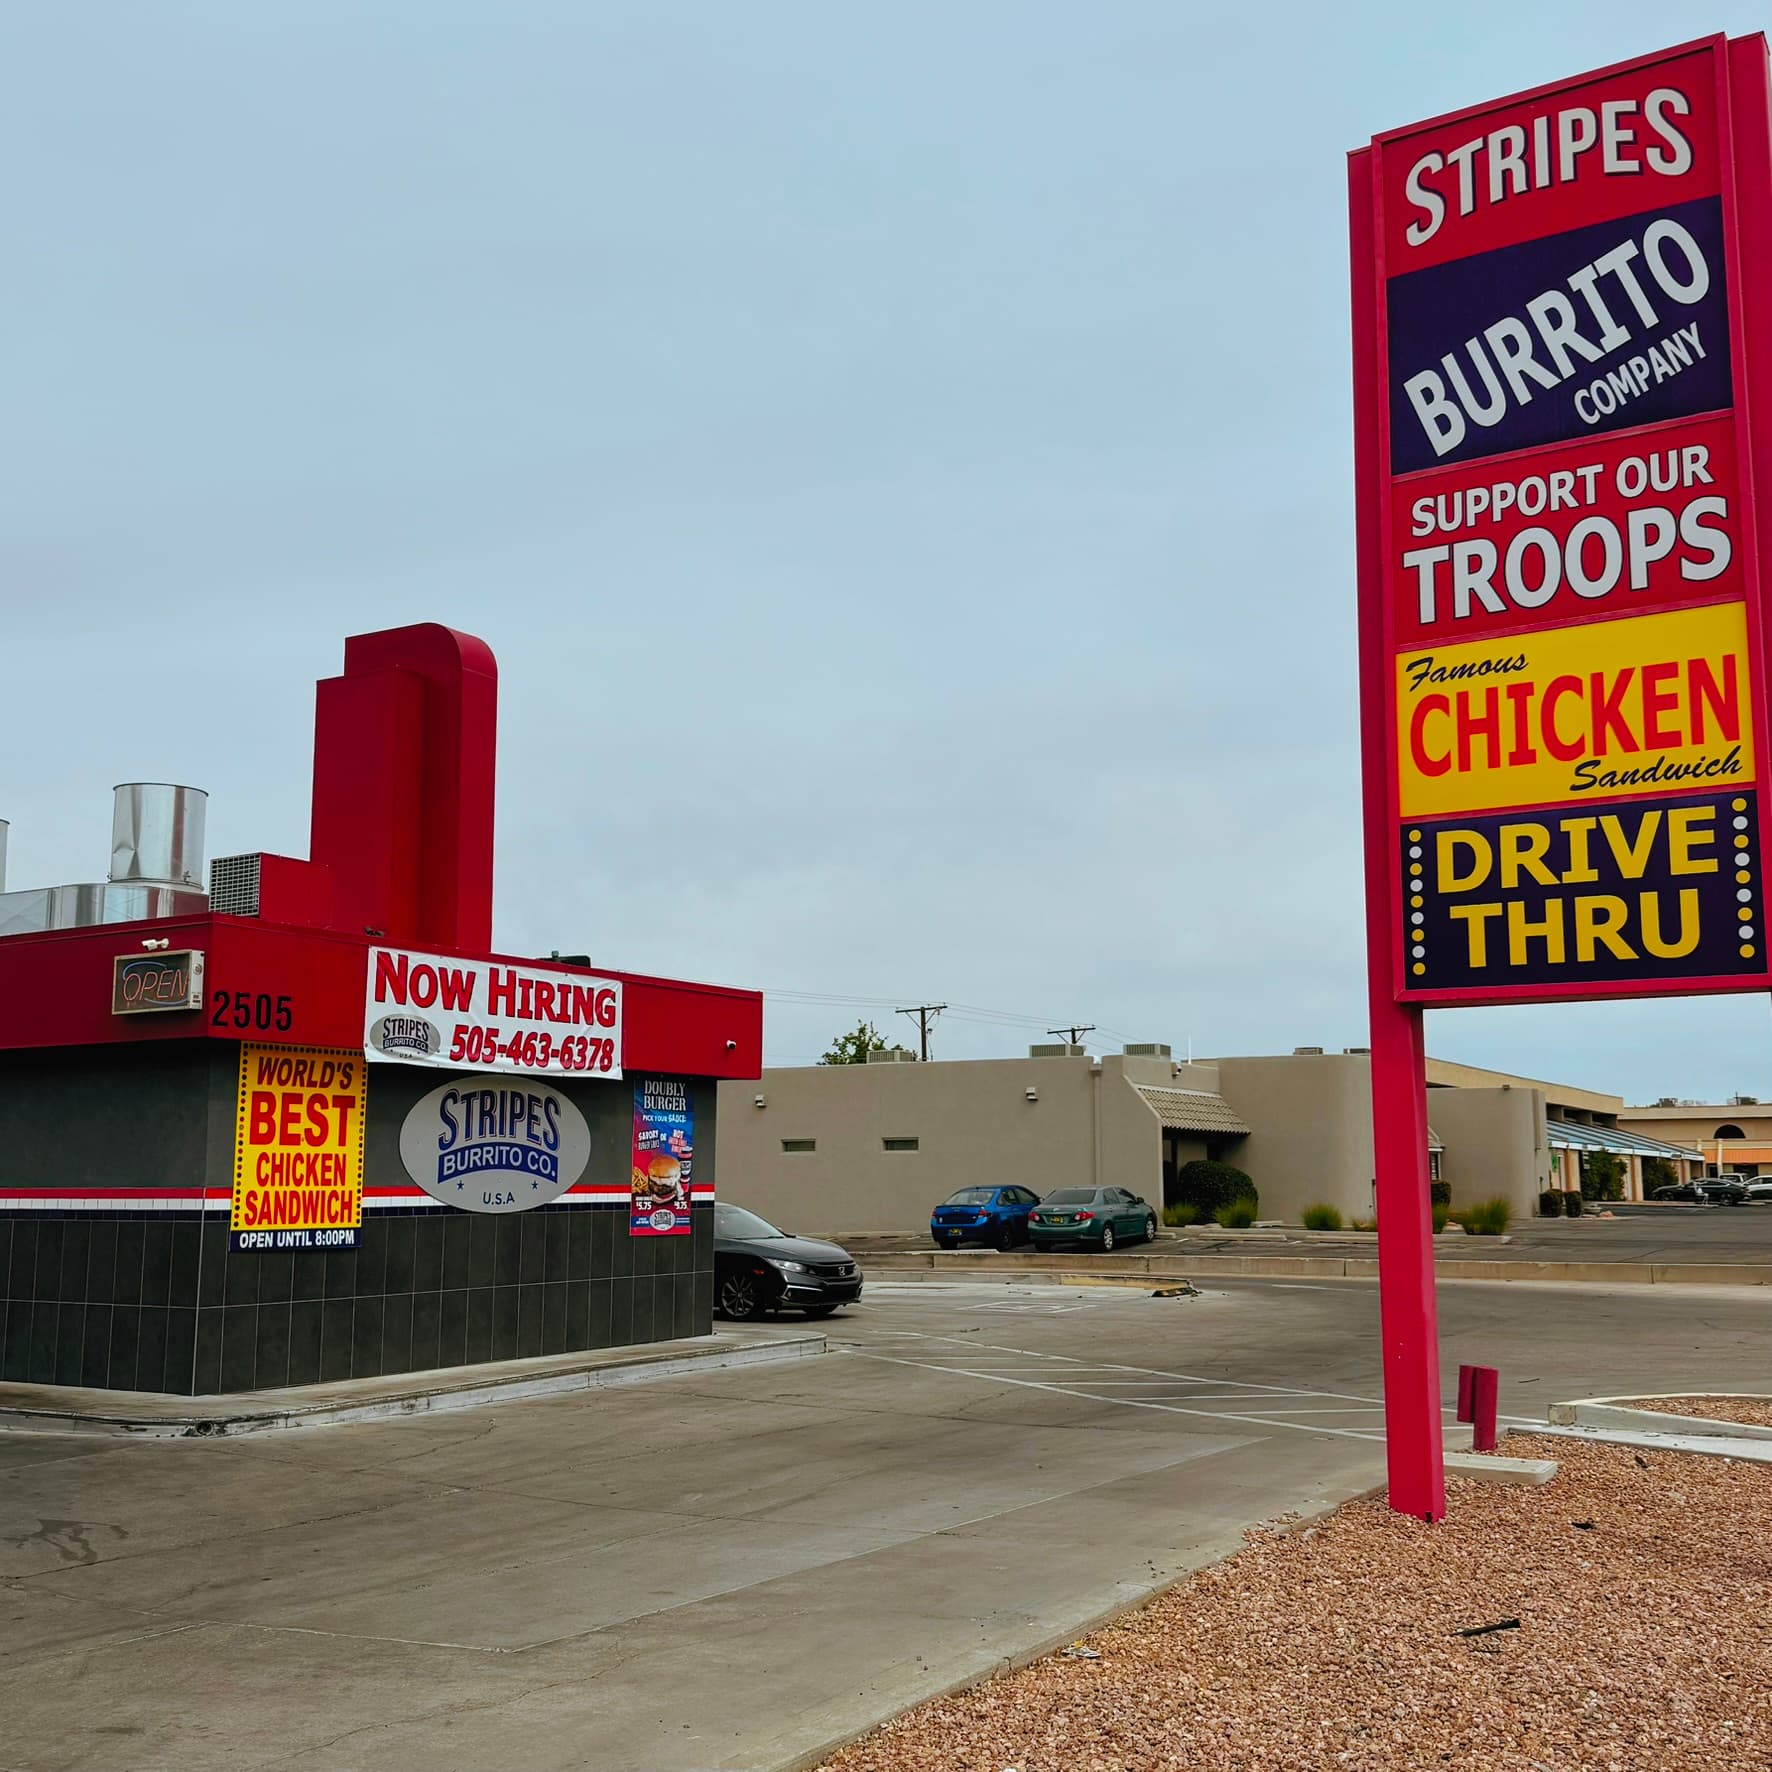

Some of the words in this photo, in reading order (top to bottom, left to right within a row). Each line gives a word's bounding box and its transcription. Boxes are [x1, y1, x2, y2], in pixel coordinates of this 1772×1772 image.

[1404, 88, 1694, 248] STRIPES
[1402, 218, 1710, 457] BURRITO
[1573, 321, 1707, 425] COMPANY
[1410, 463, 1604, 538] SUPPORT
[1615, 444, 1715, 499] OUR
[1402, 495, 1733, 626] TROOPS
[1406, 653, 1530, 692] Famous
[1409, 653, 1741, 778] CHICKEN
[1569, 745, 1743, 792] Sandwich
[1435, 804, 1719, 895] DRIVE
[1449, 888, 1701, 969] THRU
[123, 969, 190, 1001] OPEN
[374, 951, 477, 1013] NOW
[488, 966, 617, 1028] HIRING
[211, 990, 293, 1032] 2505
[382, 1018, 430, 1042] STRIPES
[384, 1038, 415, 1048] BURRITO
[450, 1025, 615, 1073] 505-463-6378
[256, 1056, 354, 1090] WORLD'S
[644, 1080, 686, 1097] DOUBLY
[249, 1091, 356, 1147] BEST
[438, 1088, 561, 1151] STRIPES
[643, 1096, 687, 1111] BURGER
[256, 1152, 347, 1187] CHICKEN
[443, 1145, 523, 1176] BURRITO
[527, 1151, 556, 1177] CO.
[244, 1190, 353, 1226] SANDWICH
[482, 1191, 515, 1205] U.S.A
[239, 1231, 274, 1248] OPEN
[277, 1231, 312, 1247] UNTIL
[315, 1230, 355, 1246] 8:00PM
